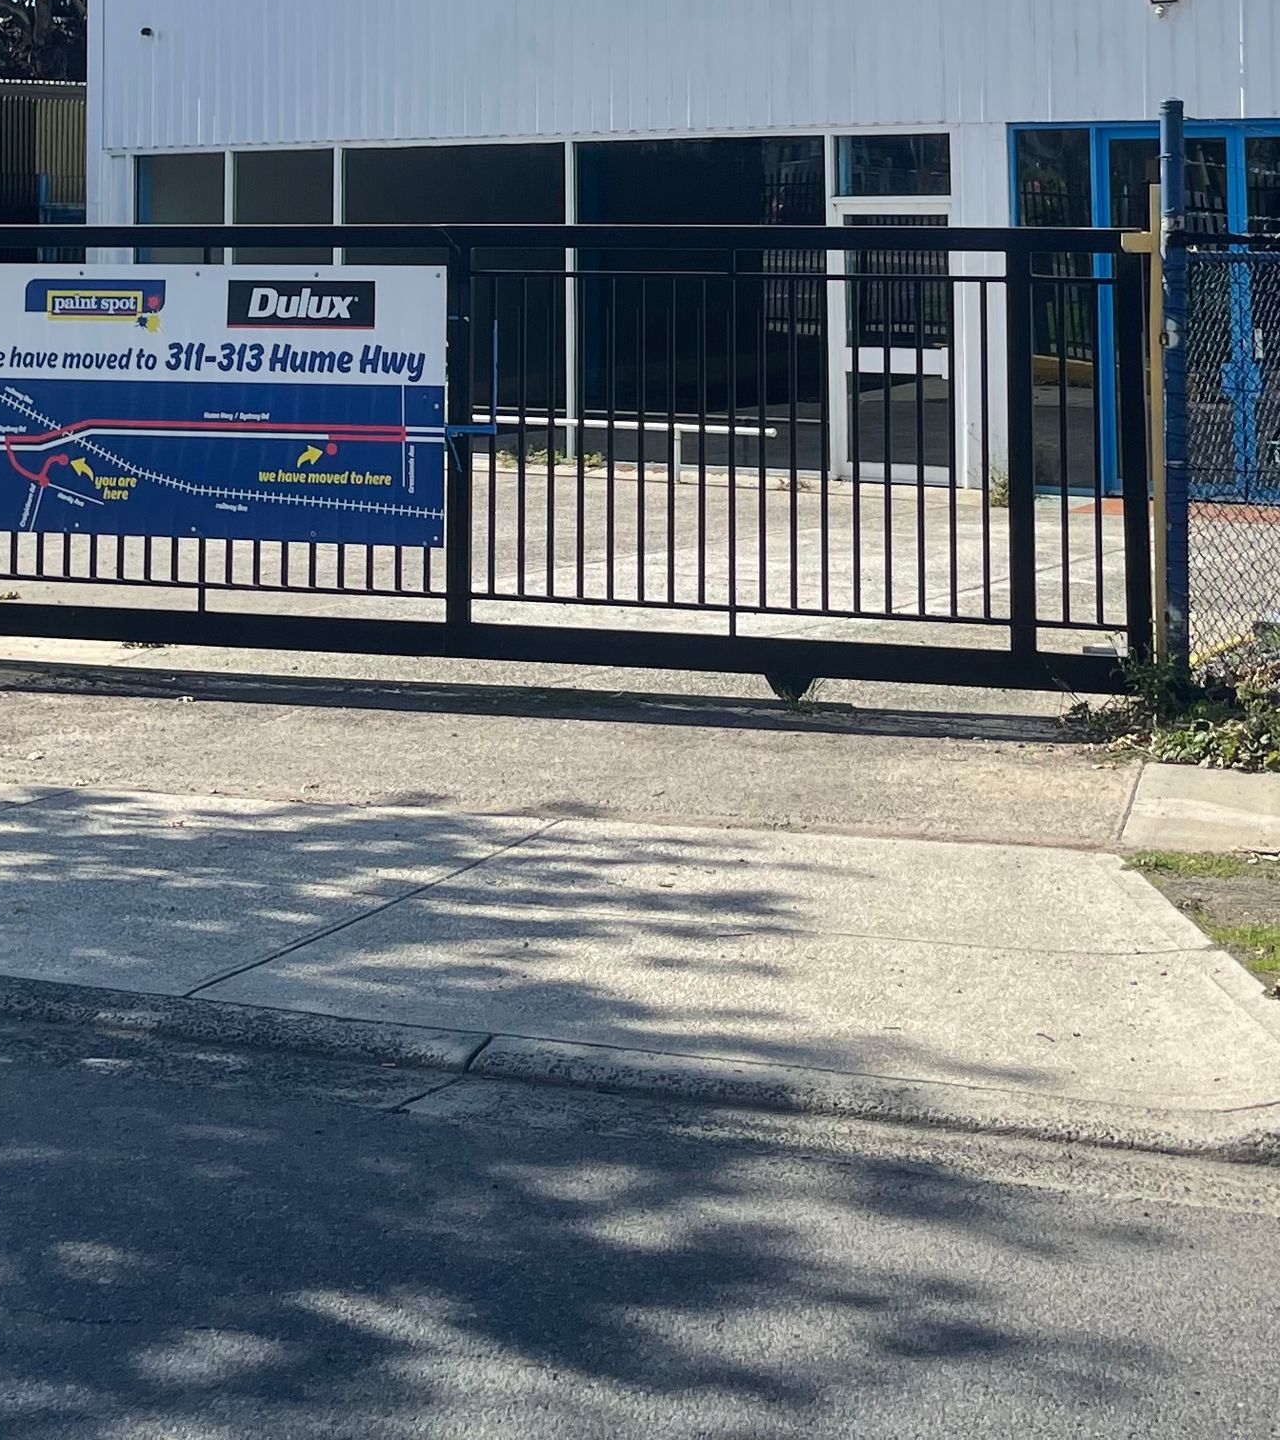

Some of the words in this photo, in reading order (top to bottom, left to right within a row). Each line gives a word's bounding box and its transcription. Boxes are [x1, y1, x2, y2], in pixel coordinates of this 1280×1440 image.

[54, 294, 97, 313] paint
[101, 296, 136, 314] spot
[247, 287, 353, 319] Dulux
[10, 346, 58, 369] have
[62, 348, 133, 370] moved
[136, 348, 157, 370] to
[166, 343, 264, 372] 311-313
[269, 343, 353, 373] Hume
[359, 344, 425, 382] Hwy
[95, 476, 117, 489] you
[118, 477, 137, 488] are
[258, 470, 276, 482] we
[278, 469, 306, 483] have
[308, 471, 349, 484] moved
[350, 472, 363, 484] to
[365, 471, 392, 485] here
[103, 487, 129, 500] here
